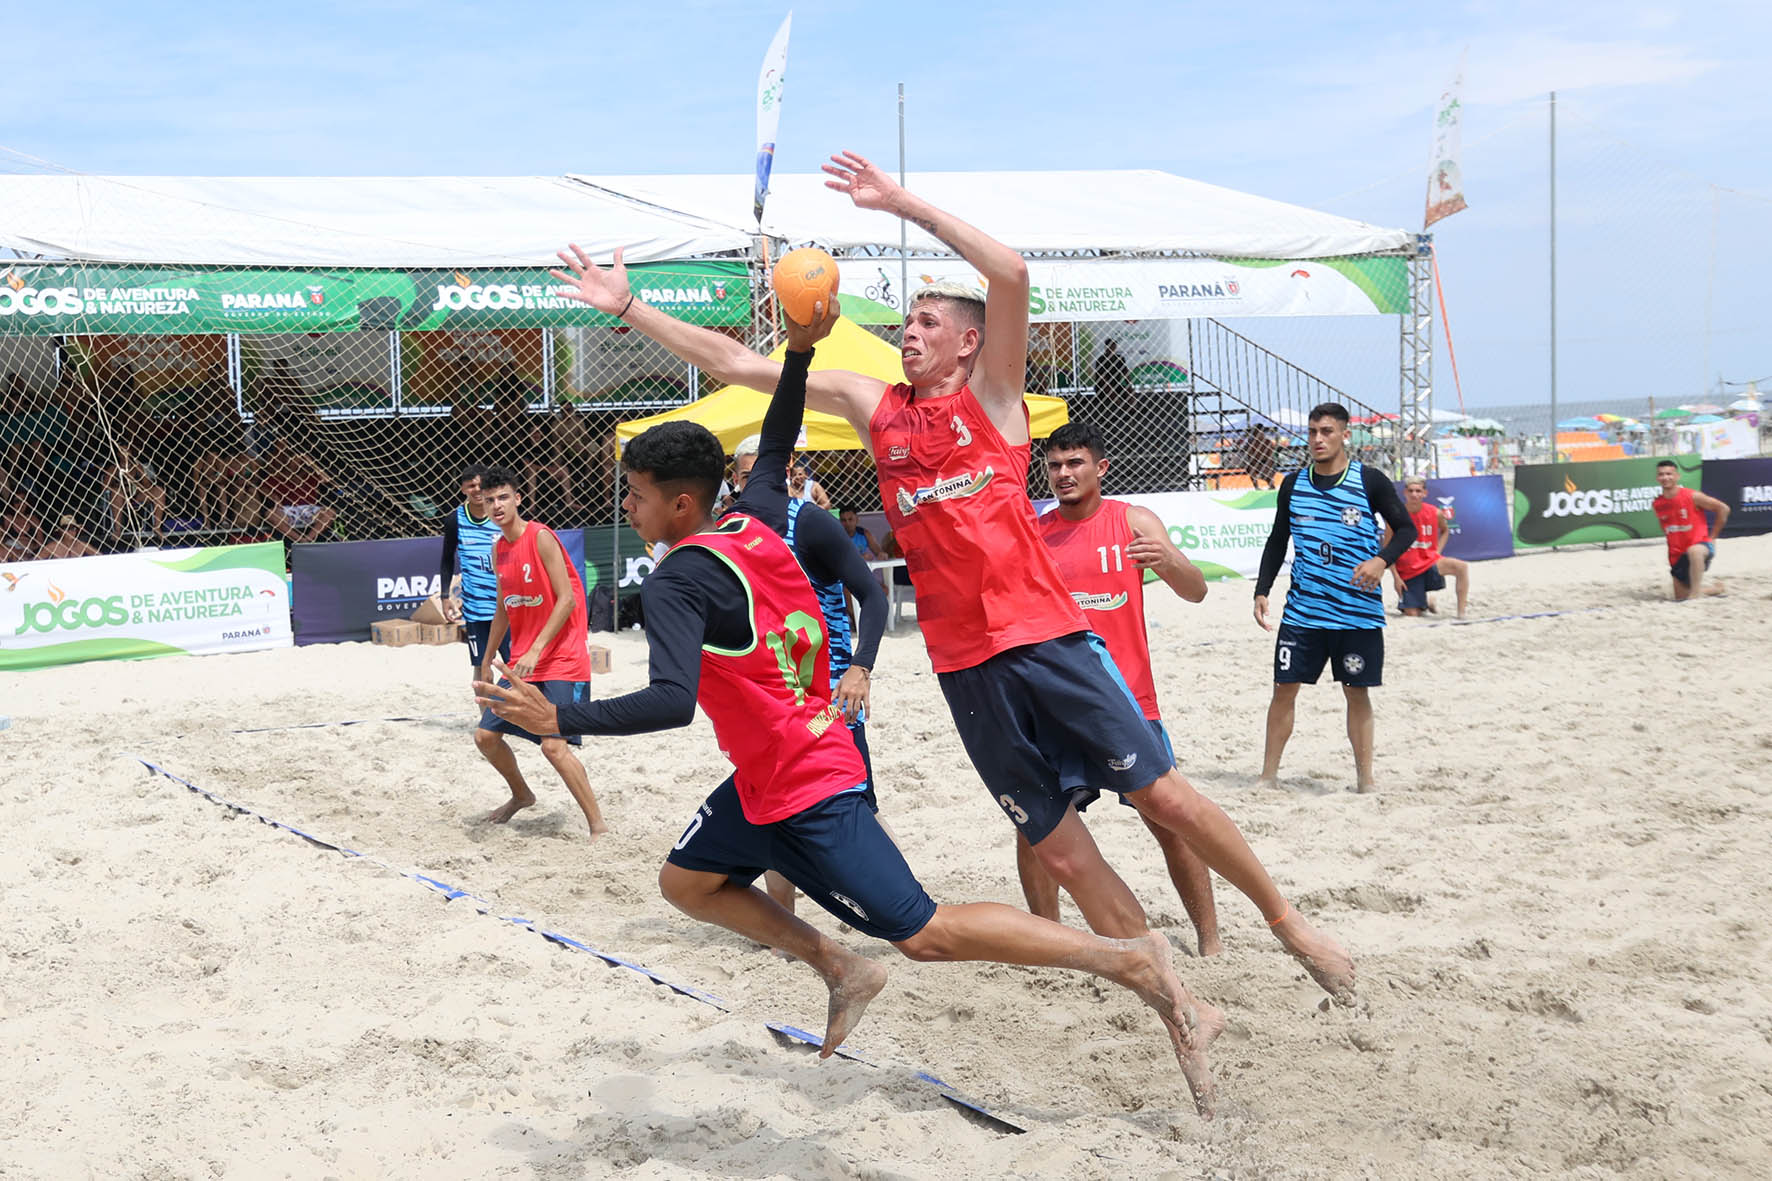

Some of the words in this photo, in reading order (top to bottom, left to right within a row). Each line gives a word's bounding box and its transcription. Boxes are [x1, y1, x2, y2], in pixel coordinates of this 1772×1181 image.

[84, 288, 107, 300] DE
[111, 287, 200, 301] AVENTURA
[432, 284, 523, 311] JOGOS
[521, 285, 542, 297] DE
[640, 286, 712, 303] PARANÁ
[1045, 287, 1062, 299] DE
[1066, 287, 1133, 299] AVENTURA
[1158, 281, 1225, 298] PARANÁ
[0, 287, 83, 316] OGOS
[85, 302, 98, 315] &
[100, 301, 190, 315] NATUREZA
[221, 291, 307, 309] PARANÁ
[524, 298, 535, 309] &
[1047, 302, 1056, 312] &
[1058, 299, 1127, 312] NATUREZA
[950, 415, 973, 447] 3
[1542, 489, 1613, 518] JOGOS
[1613, 489, 1629, 500] DE
[1201, 526, 1216, 536] DE
[1096, 544, 1123, 573] 11
[1320, 542, 1332, 565] 9
[523, 563, 533, 583] 2
[131, 594, 154, 608] DE
[160, 585, 254, 606] AVENTURA
[377, 574, 441, 599] PARA
[15, 595, 129, 635] JOGOS
[132, 611, 143, 624] &
[148, 603, 243, 623] NATUREZA
[222, 628, 262, 640] PARANÁ
[1279, 647, 1291, 670] 9
[1000, 794, 1028, 824] 3
